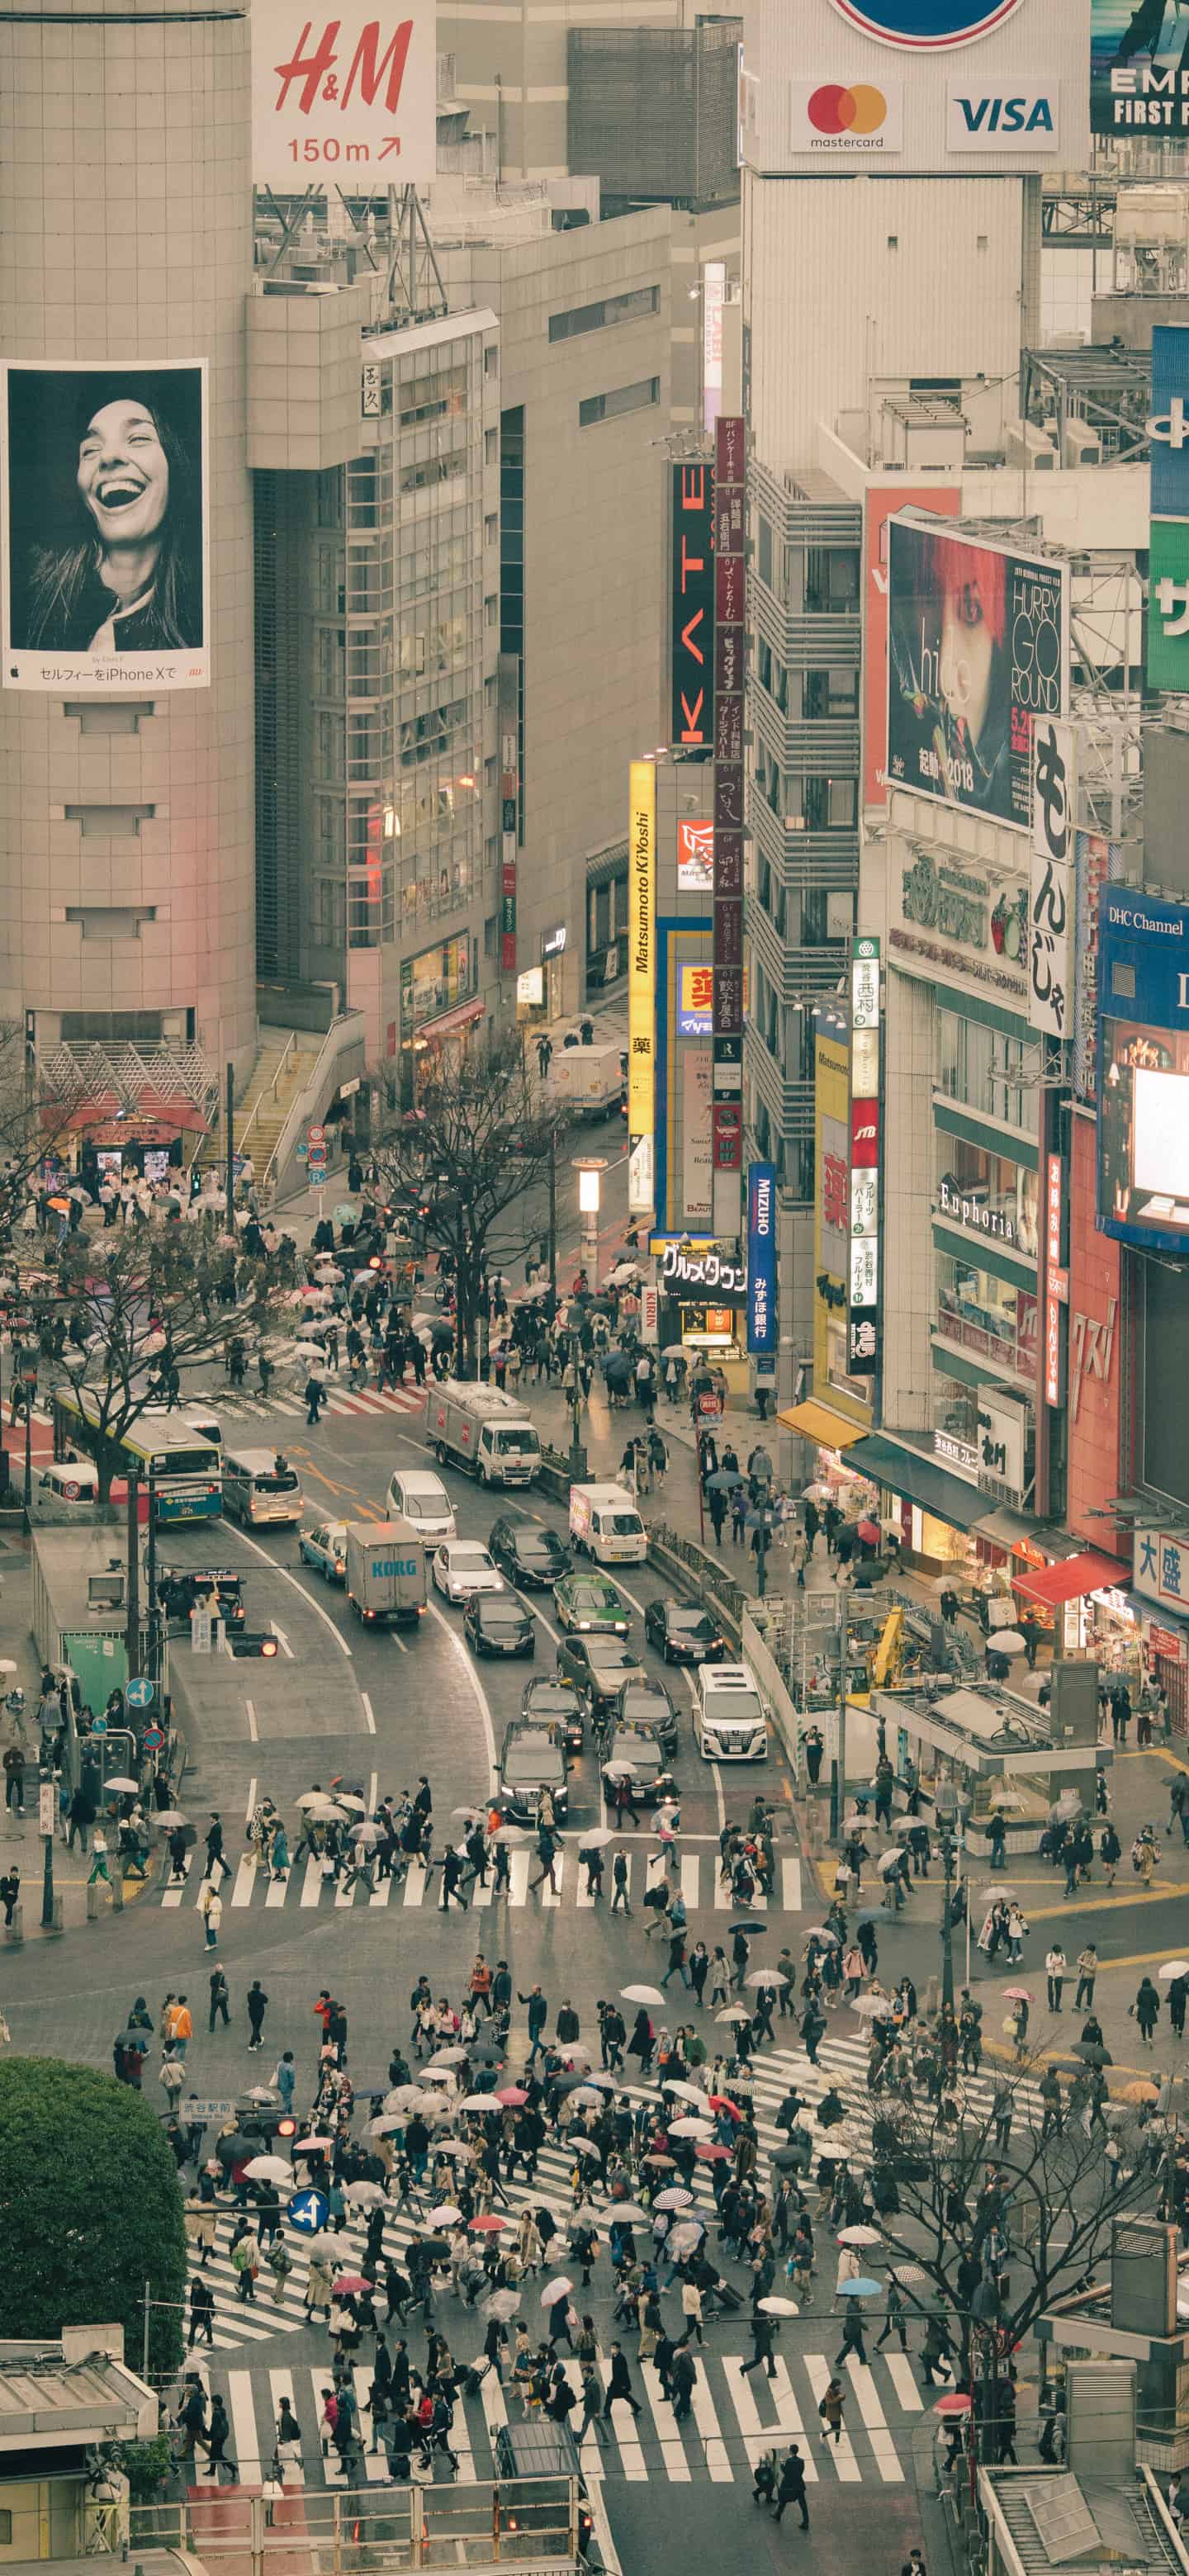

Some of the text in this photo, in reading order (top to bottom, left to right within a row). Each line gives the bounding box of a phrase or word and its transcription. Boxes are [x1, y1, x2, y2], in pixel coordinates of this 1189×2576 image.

[274, 20, 413, 115] H&M
[952, 98, 1054, 132] VISA
[287, 138, 370, 162] 150m
[810, 136, 884, 149] mastercard
[682, 465, 704, 743] KATE
[1012, 580, 1060, 626] HURRY
[1011, 613, 1060, 680] GO
[1011, 667, 1059, 713] ROUND
[635, 812, 649, 974] Matsumoto KiYoshi
[1032, 723, 1069, 1031] もんじゃ
[1109, 906, 1184, 935] DHC Channel
[632, 1037, 651, 1054] 薬
[757, 1179, 770, 1236] MIZUHO
[940, 1181, 1015, 1238] Euphoria
[663, 1244, 748, 1291] グルメタウン
[646, 1292, 656, 1328] KIRIN
[961, 1448, 978, 1466] フルー
[372, 1559, 417, 1579] KORG
